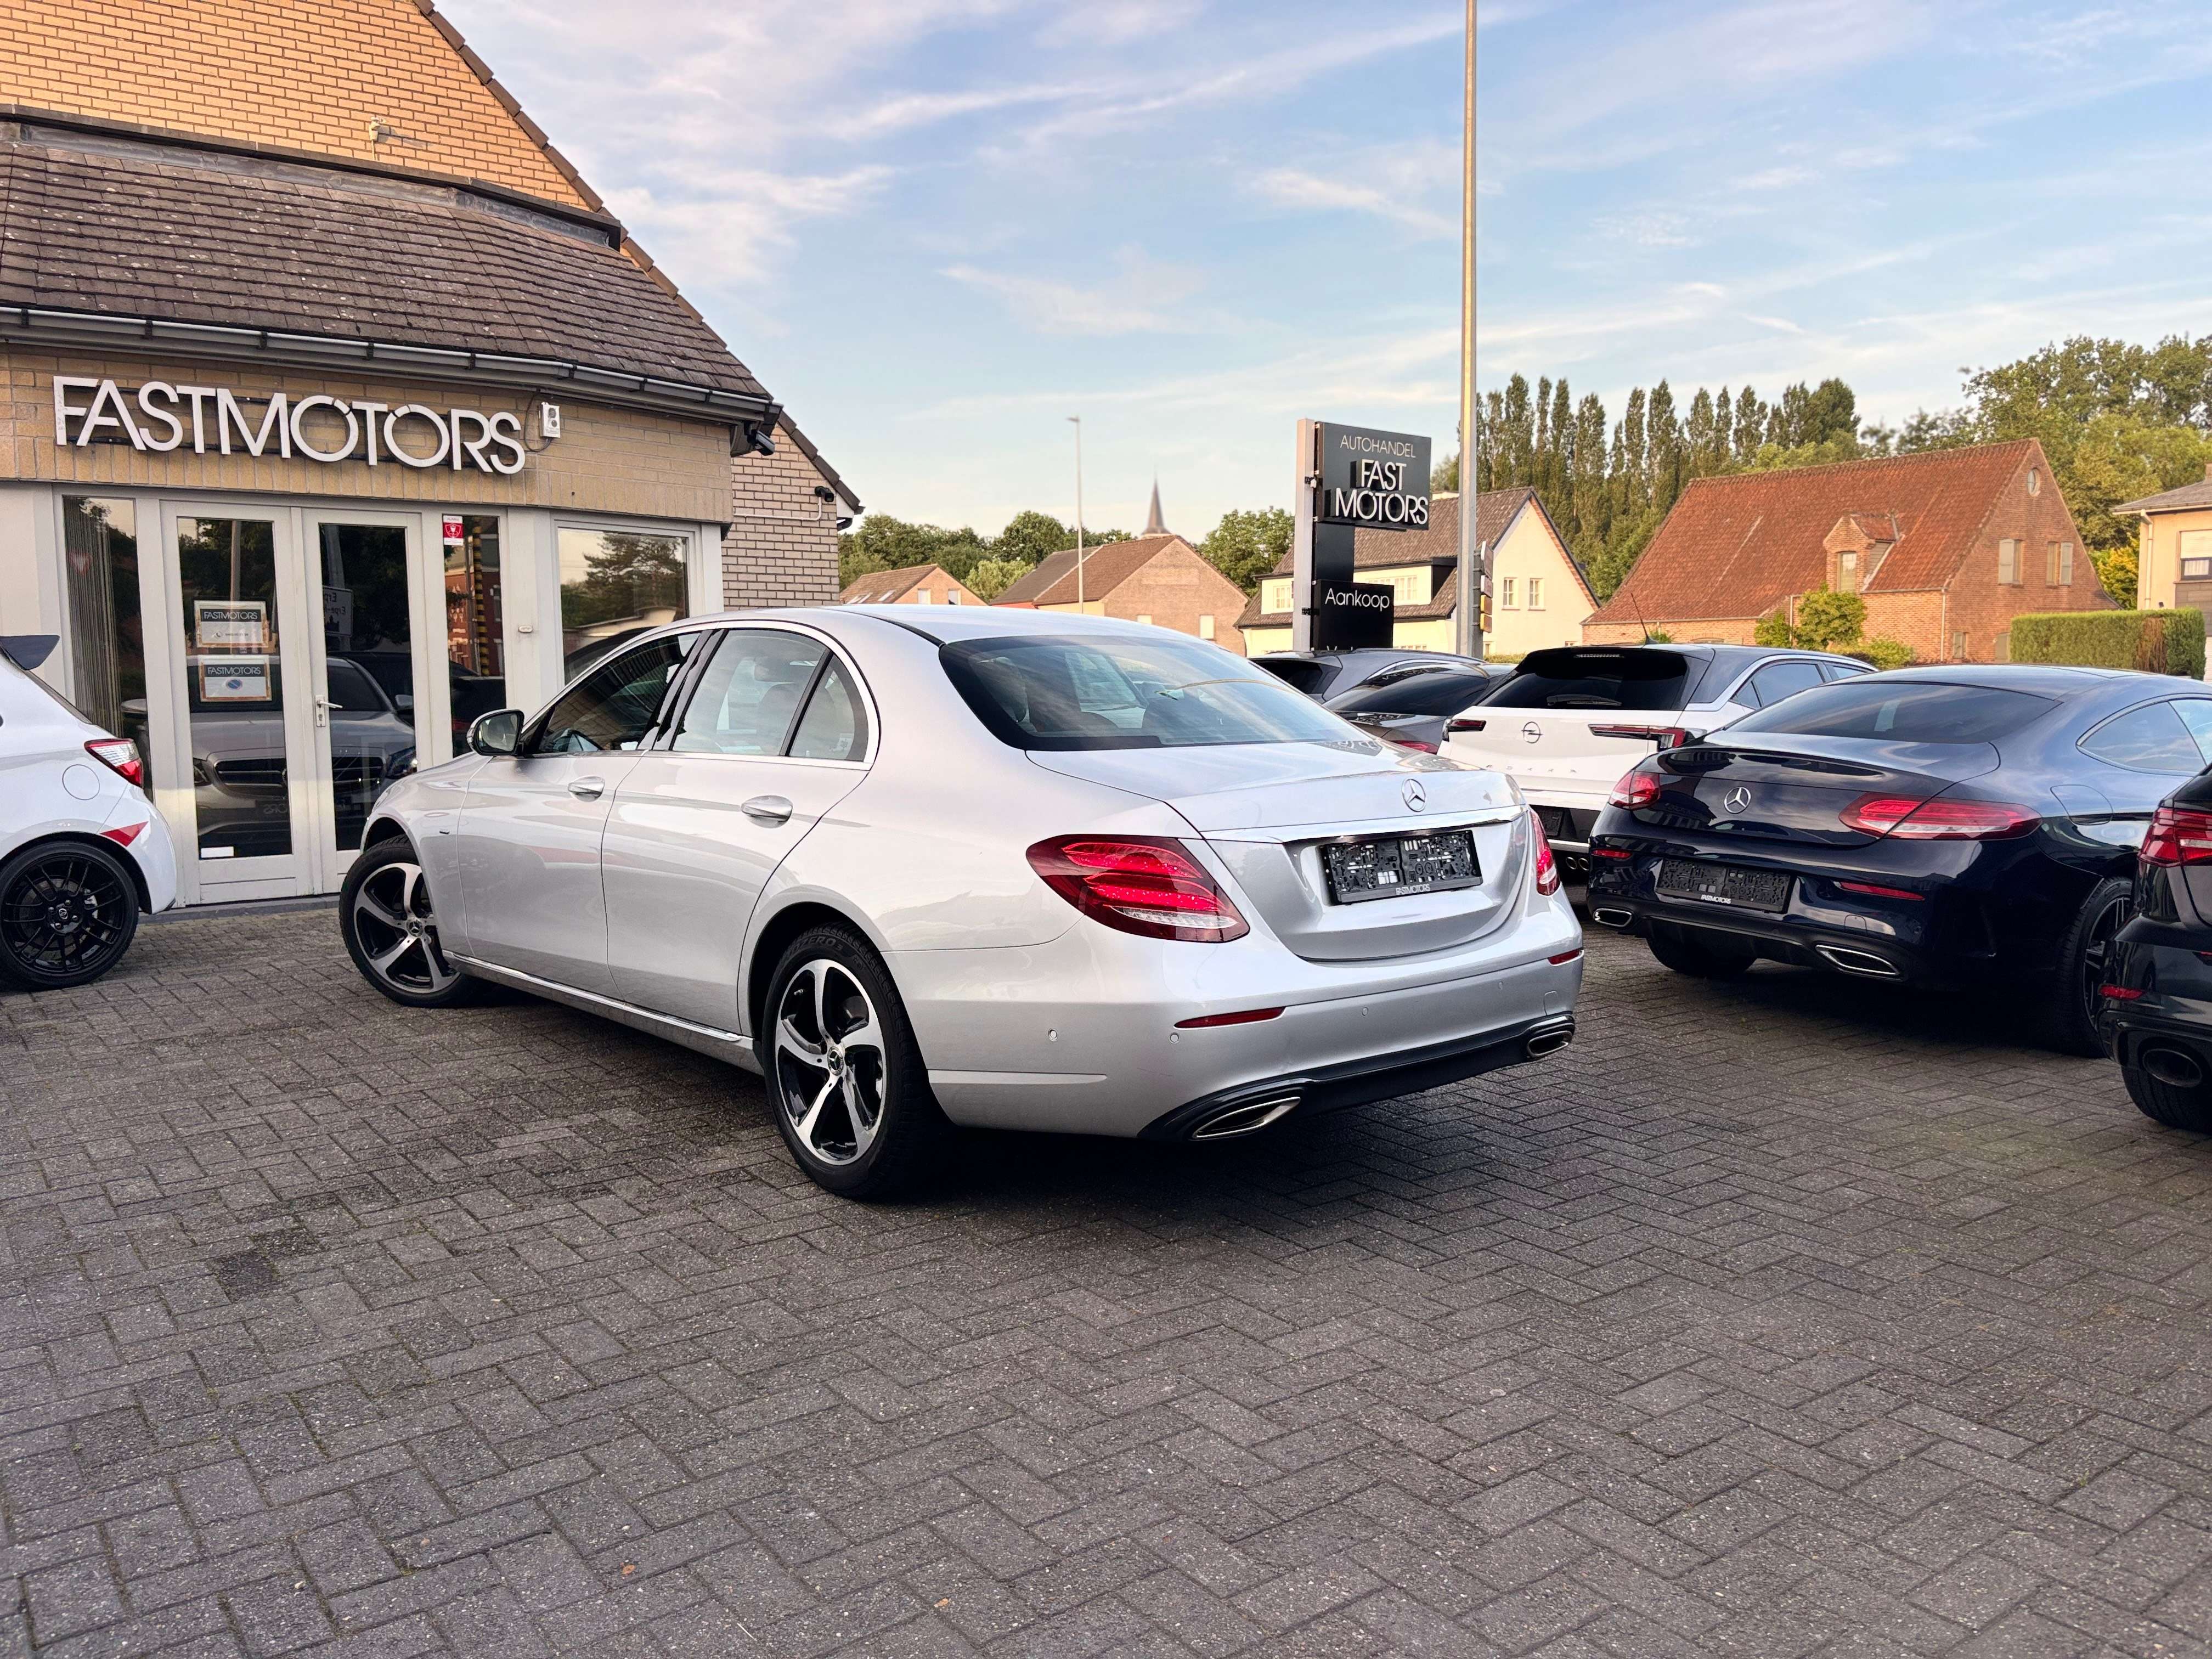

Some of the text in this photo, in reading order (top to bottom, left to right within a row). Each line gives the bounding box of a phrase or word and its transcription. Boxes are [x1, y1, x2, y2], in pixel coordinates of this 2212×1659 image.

[53, 375, 526, 475] FASTMOTORS
[1340, 435, 1416, 458] AUTOHANDEL
[1361, 459, 1407, 490] FAST
[1335, 488, 1429, 525] MOTORS
[1325, 588, 1390, 611] Aankoop
[204, 611, 258, 620] FASTMOTORS
[207, 667, 261, 675] FASTMOTORS
